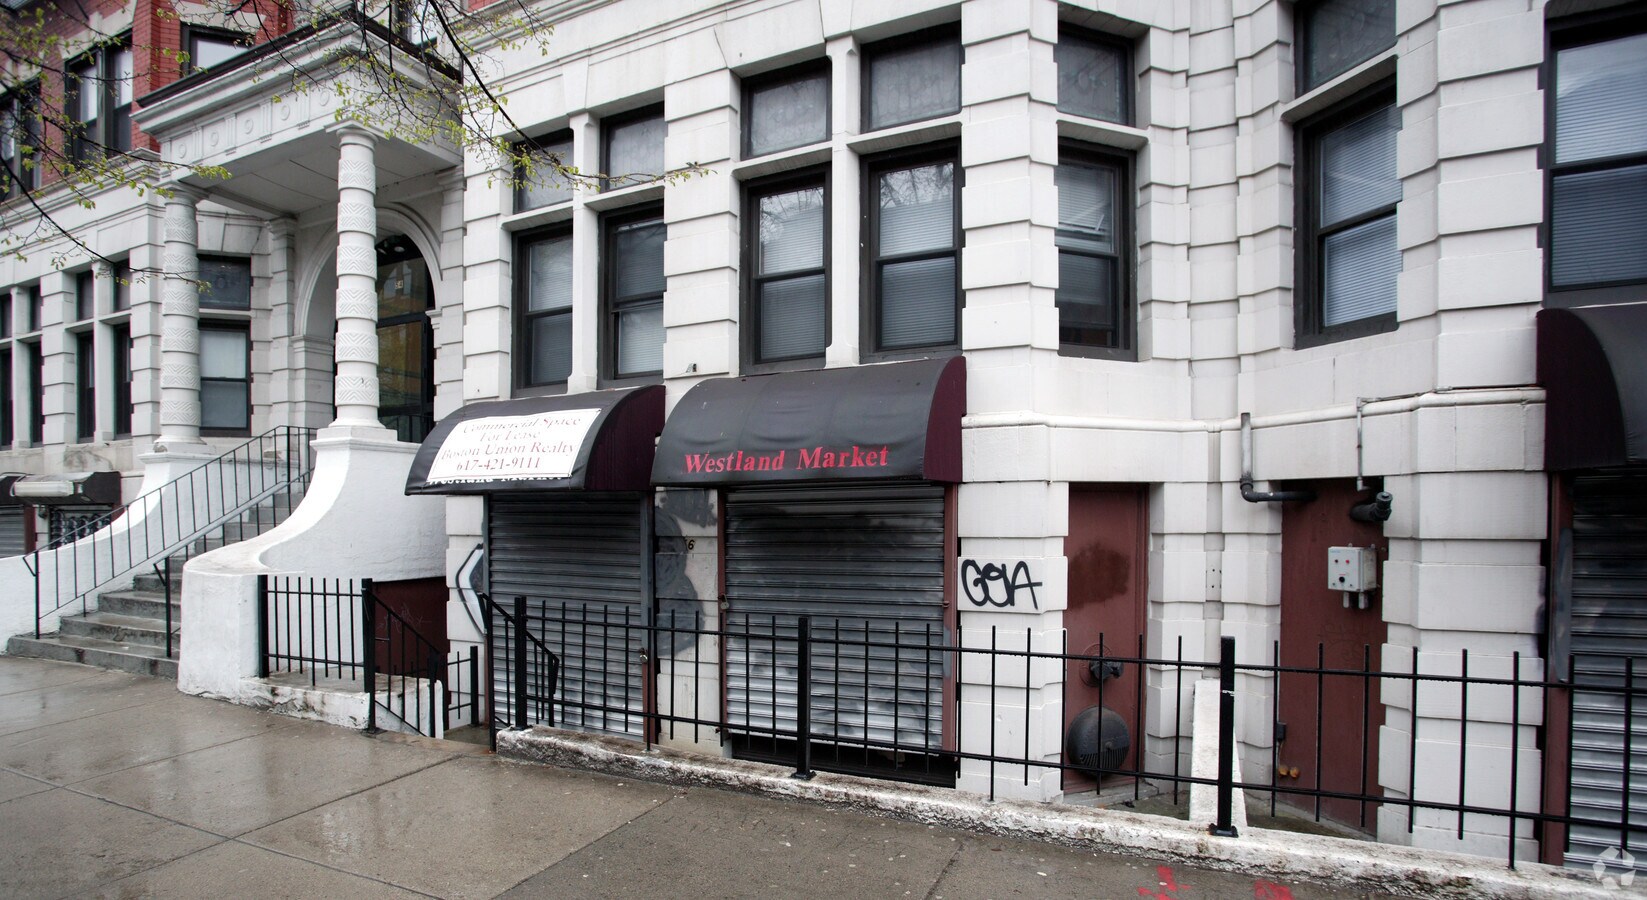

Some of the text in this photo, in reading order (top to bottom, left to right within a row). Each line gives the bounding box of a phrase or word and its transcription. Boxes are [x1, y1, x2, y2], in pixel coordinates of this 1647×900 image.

[463, 416, 582, 434] Commercial Space
[480, 430, 541, 442] For Lease
[442, 441, 574, 460] Boston Union Realty
[684, 445, 888, 474] Westland Market
[456, 457, 541, 471] 617-421-9111
